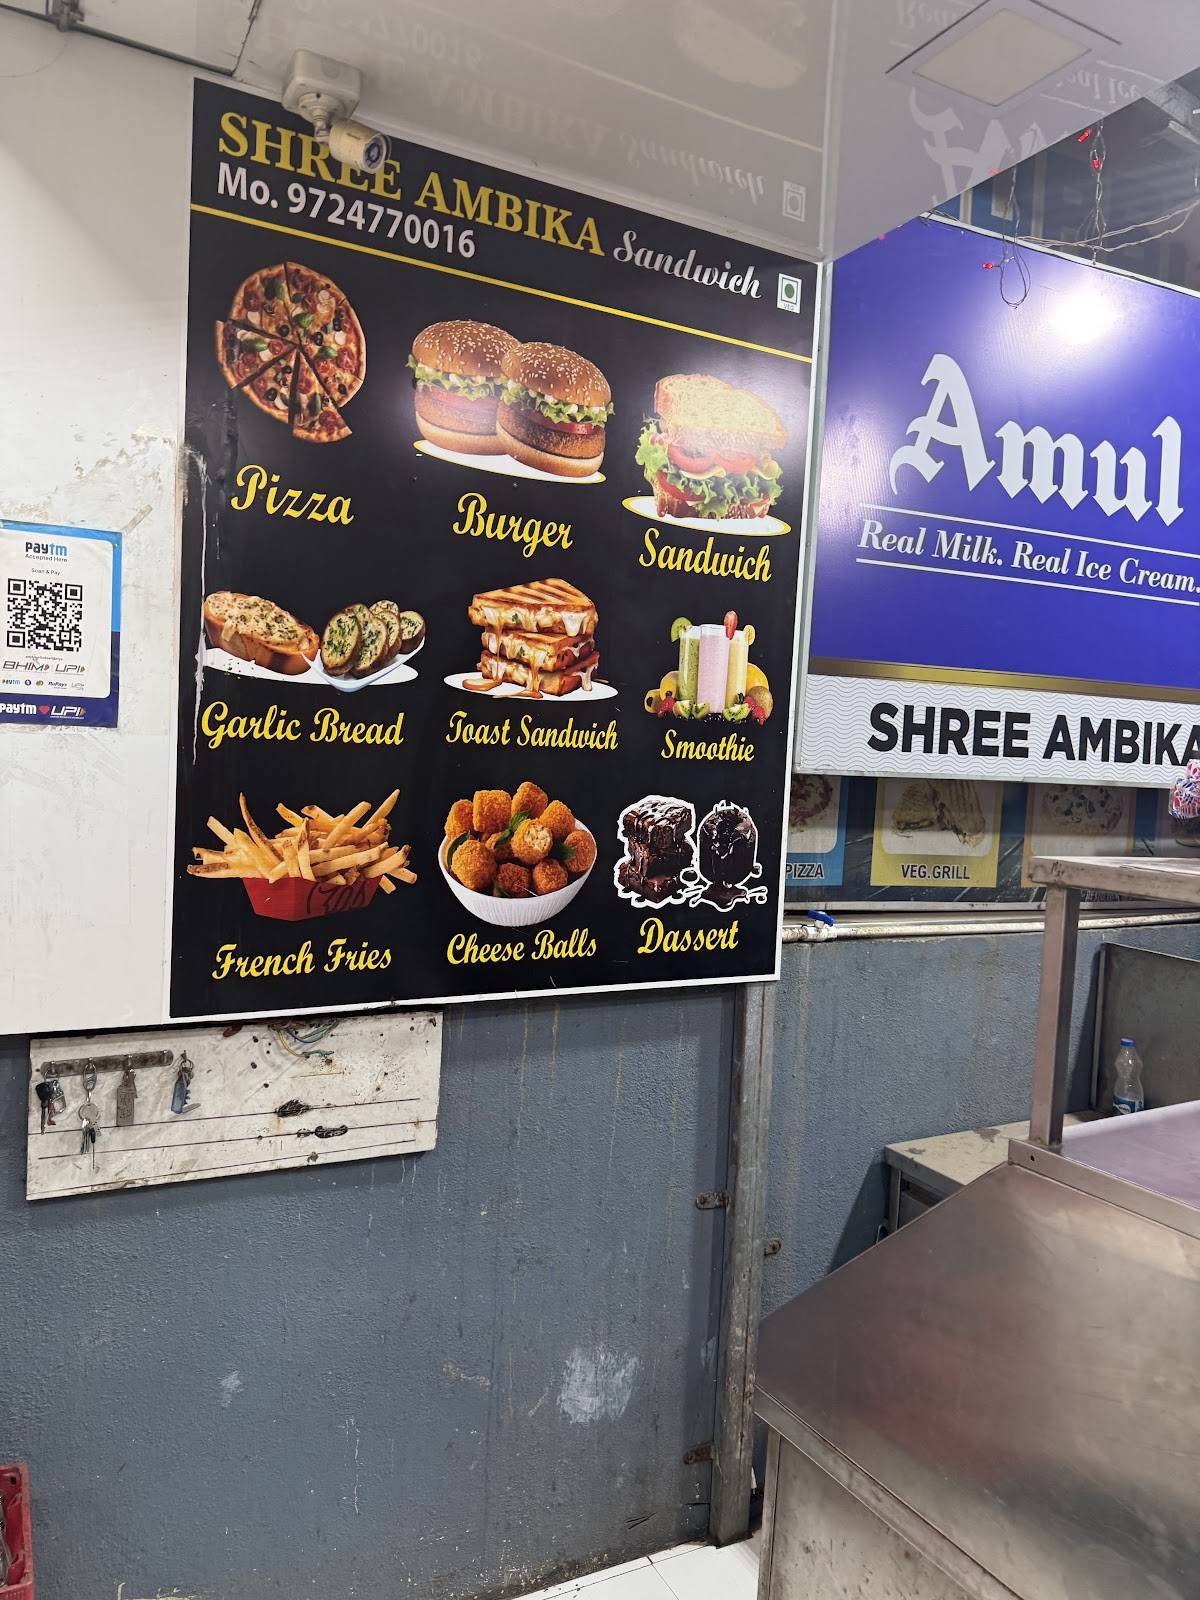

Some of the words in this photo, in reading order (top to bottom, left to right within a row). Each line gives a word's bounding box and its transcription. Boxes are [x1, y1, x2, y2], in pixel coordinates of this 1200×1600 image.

[217, 161, 279, 209] Mo.
[287, 182, 477, 259] 9724770016
[414, 171, 606, 258] AMBIKA
[612, 229, 764, 300] Sandwich
[889, 353, 1184, 527] Amul
[230, 463, 355, 526] Pizza
[452, 492, 574, 559] Burger
[637, 527, 772, 583] Sandwich
[857, 518, 927, 556] Real
[931, 529, 1004, 567] Milk.
[1010, 540, 1070, 575] Real
[1074, 549, 1112, 580] Ice
[1118, 556, 1200, 594] Cream.
[55, 663, 81, 673] UPI
[50, 705, 82, 717] UPI
[200, 700, 301, 748] Garlic
[308, 706, 404, 747] Bread
[445, 709, 511, 747] Toast
[516, 715, 619, 751] Sandwich
[867, 702, 1031, 759] SHREE
[1042, 714, 1200, 767] AMBIKA
[660, 729, 756, 763] Smoothie
[211, 940, 314, 981] French
[322, 937, 393, 975] Fries
[446, 932, 525, 966] Cheese
[530, 927, 598, 962] Balls
[637, 915, 740, 956] Dassert
